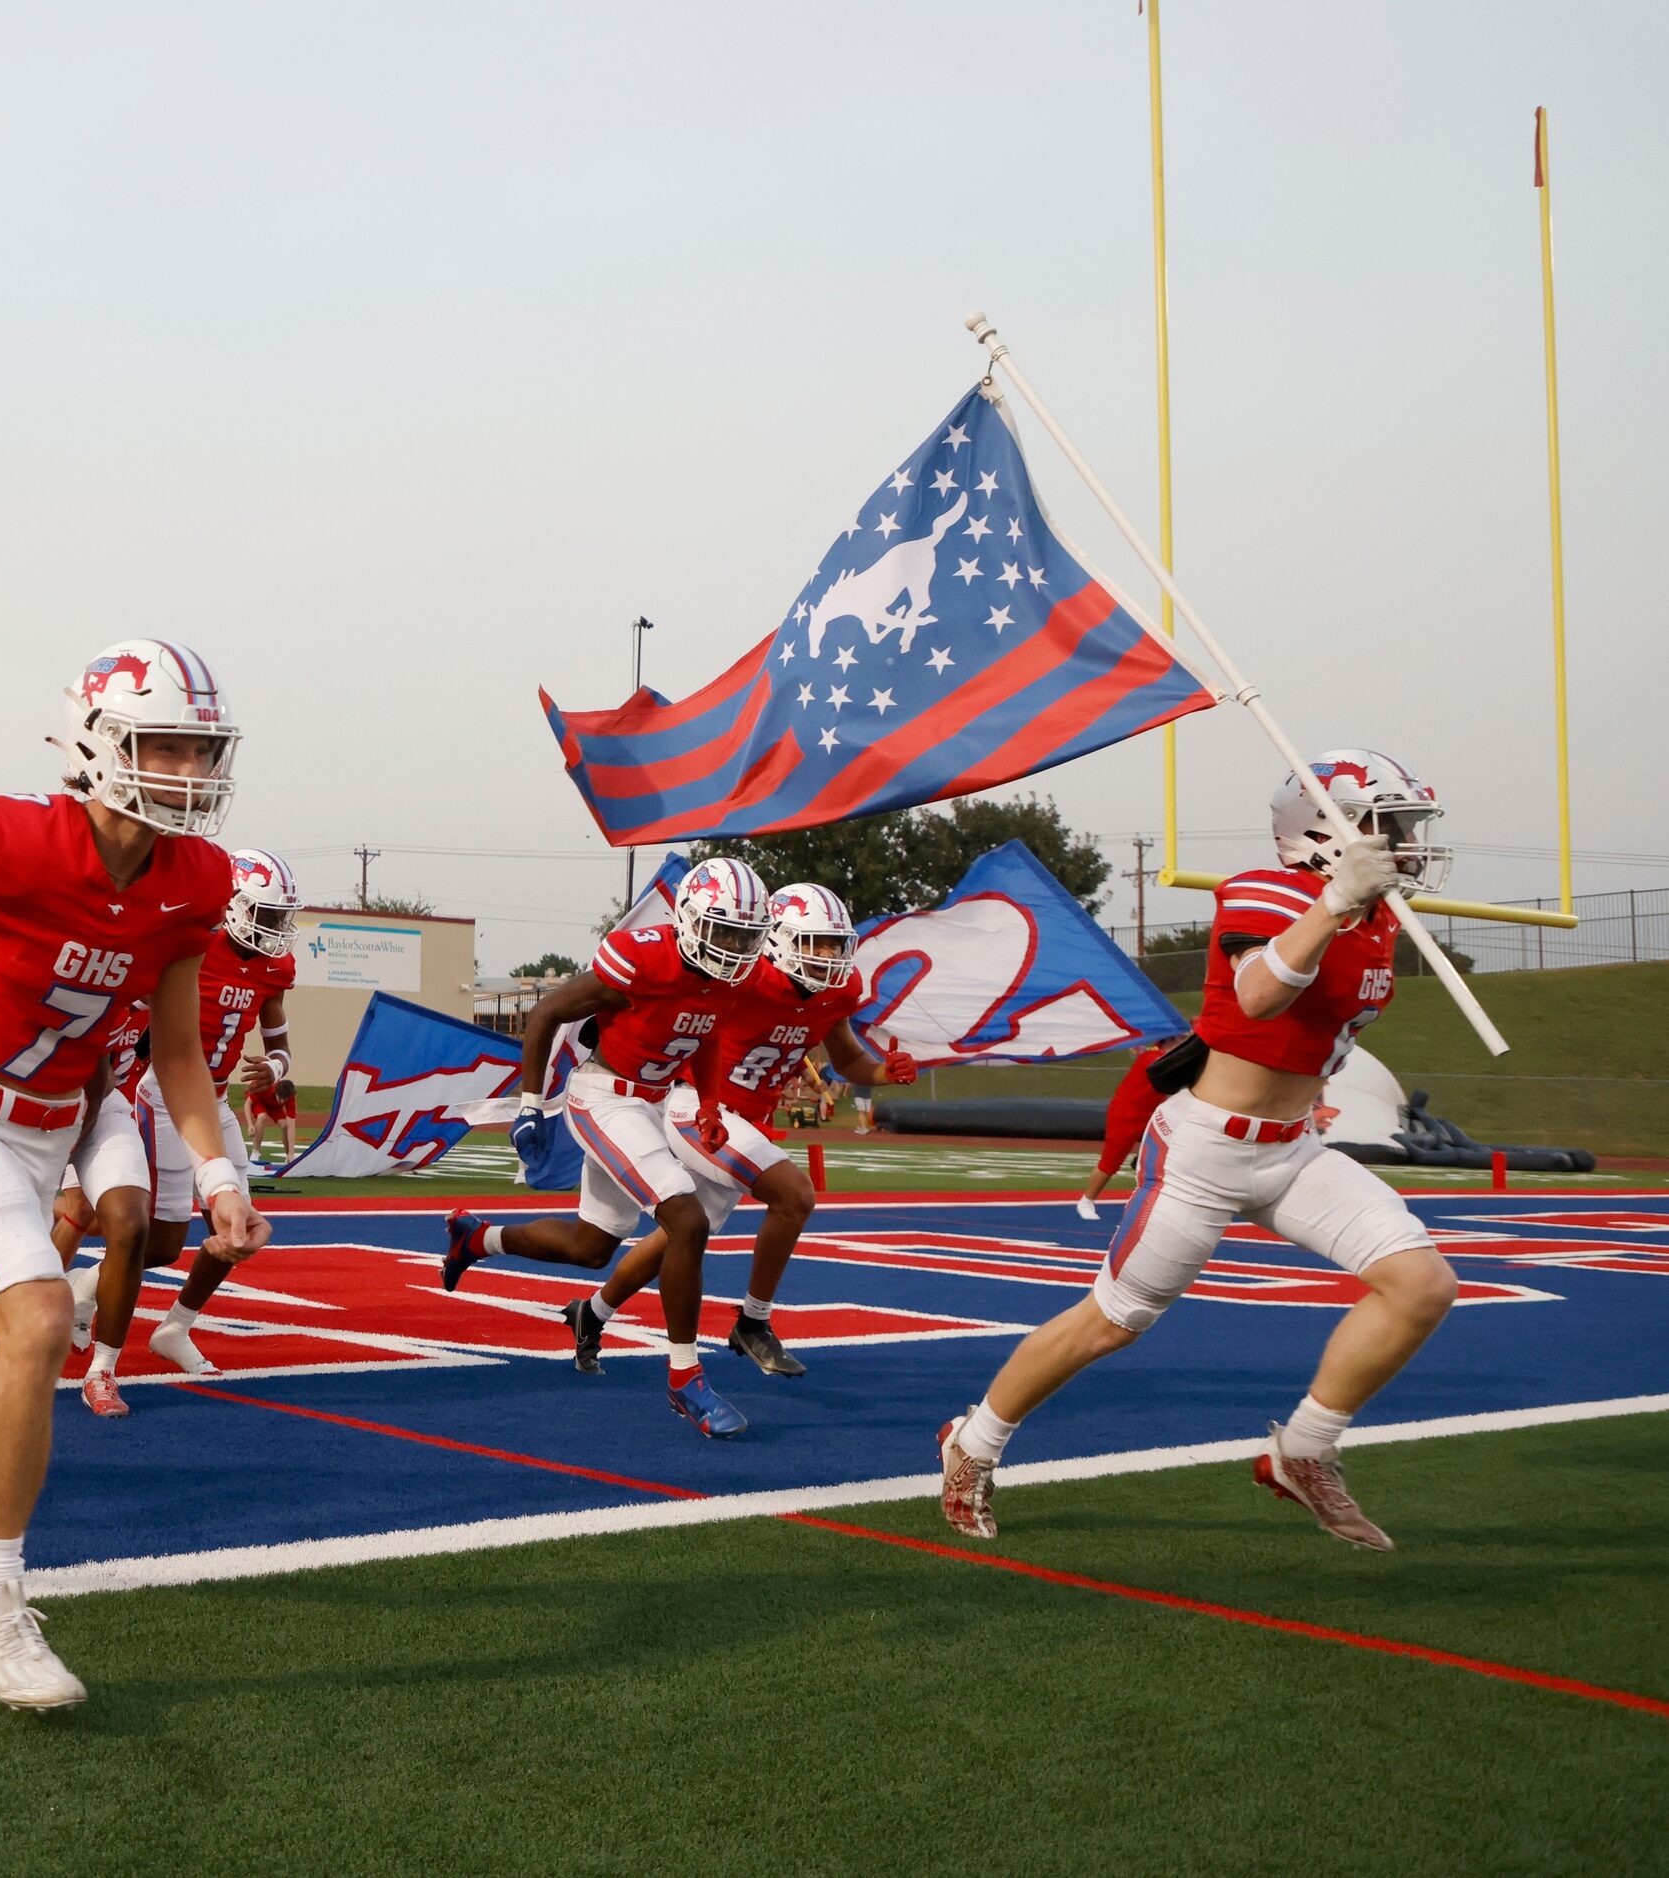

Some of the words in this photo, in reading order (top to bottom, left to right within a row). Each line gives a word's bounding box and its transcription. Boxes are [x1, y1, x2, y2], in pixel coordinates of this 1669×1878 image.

[195, 708, 219, 722] 104
[738, 911, 754, 921] 104
[328, 938, 406, 954] BaylorScott&White
[633, 928, 664, 945] 3
[54, 941, 134, 988] GHS
[1358, 968, 1393, 1000] GHS
[218, 985, 255, 1009] GHS
[2, 983, 115, 1081] 7
[672, 1012, 717, 1035] GHS
[768, 1025, 810, 1045] GHS
[207, 1011, 243, 1069] 1
[637, 1037, 701, 1083] 3
